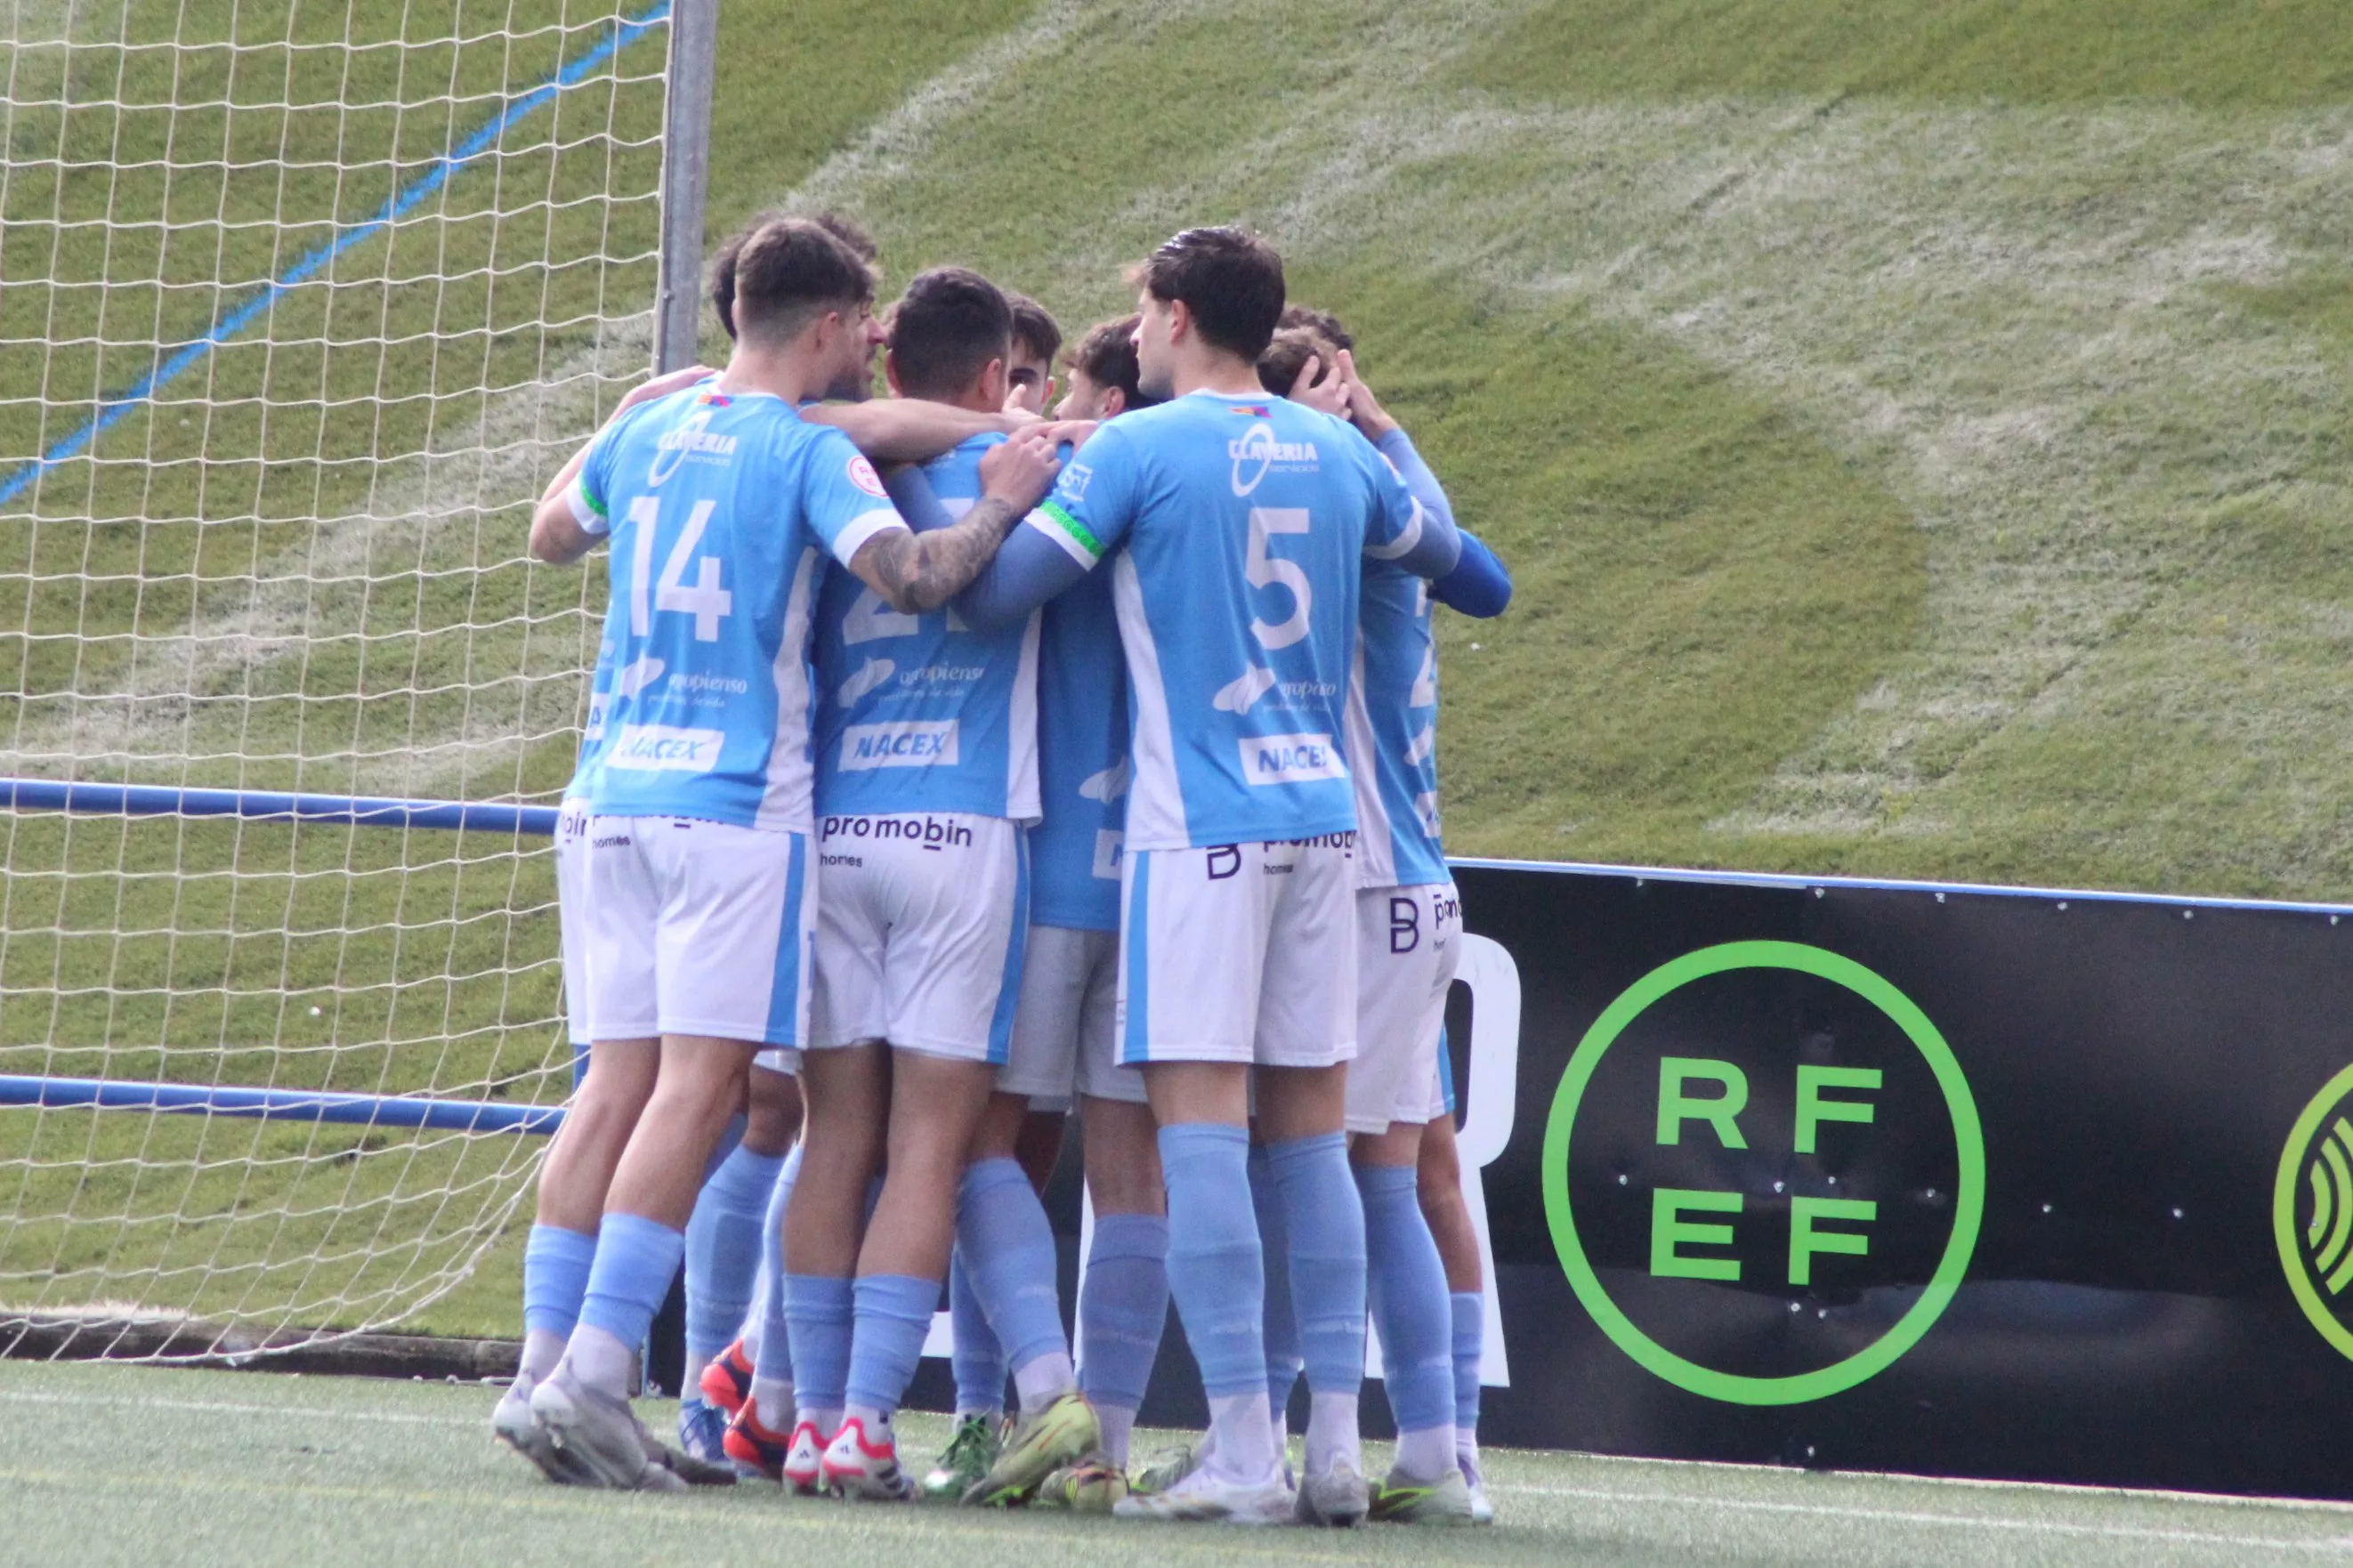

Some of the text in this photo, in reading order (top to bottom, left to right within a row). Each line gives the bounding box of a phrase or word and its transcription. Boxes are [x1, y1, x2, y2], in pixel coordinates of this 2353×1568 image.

[627, 496, 732, 643] 14
[1245, 507, 1313, 651] 5
[621, 737, 707, 760] NACEX
[854, 731, 946, 758] NACEX
[822, 815, 972, 851] promobin
